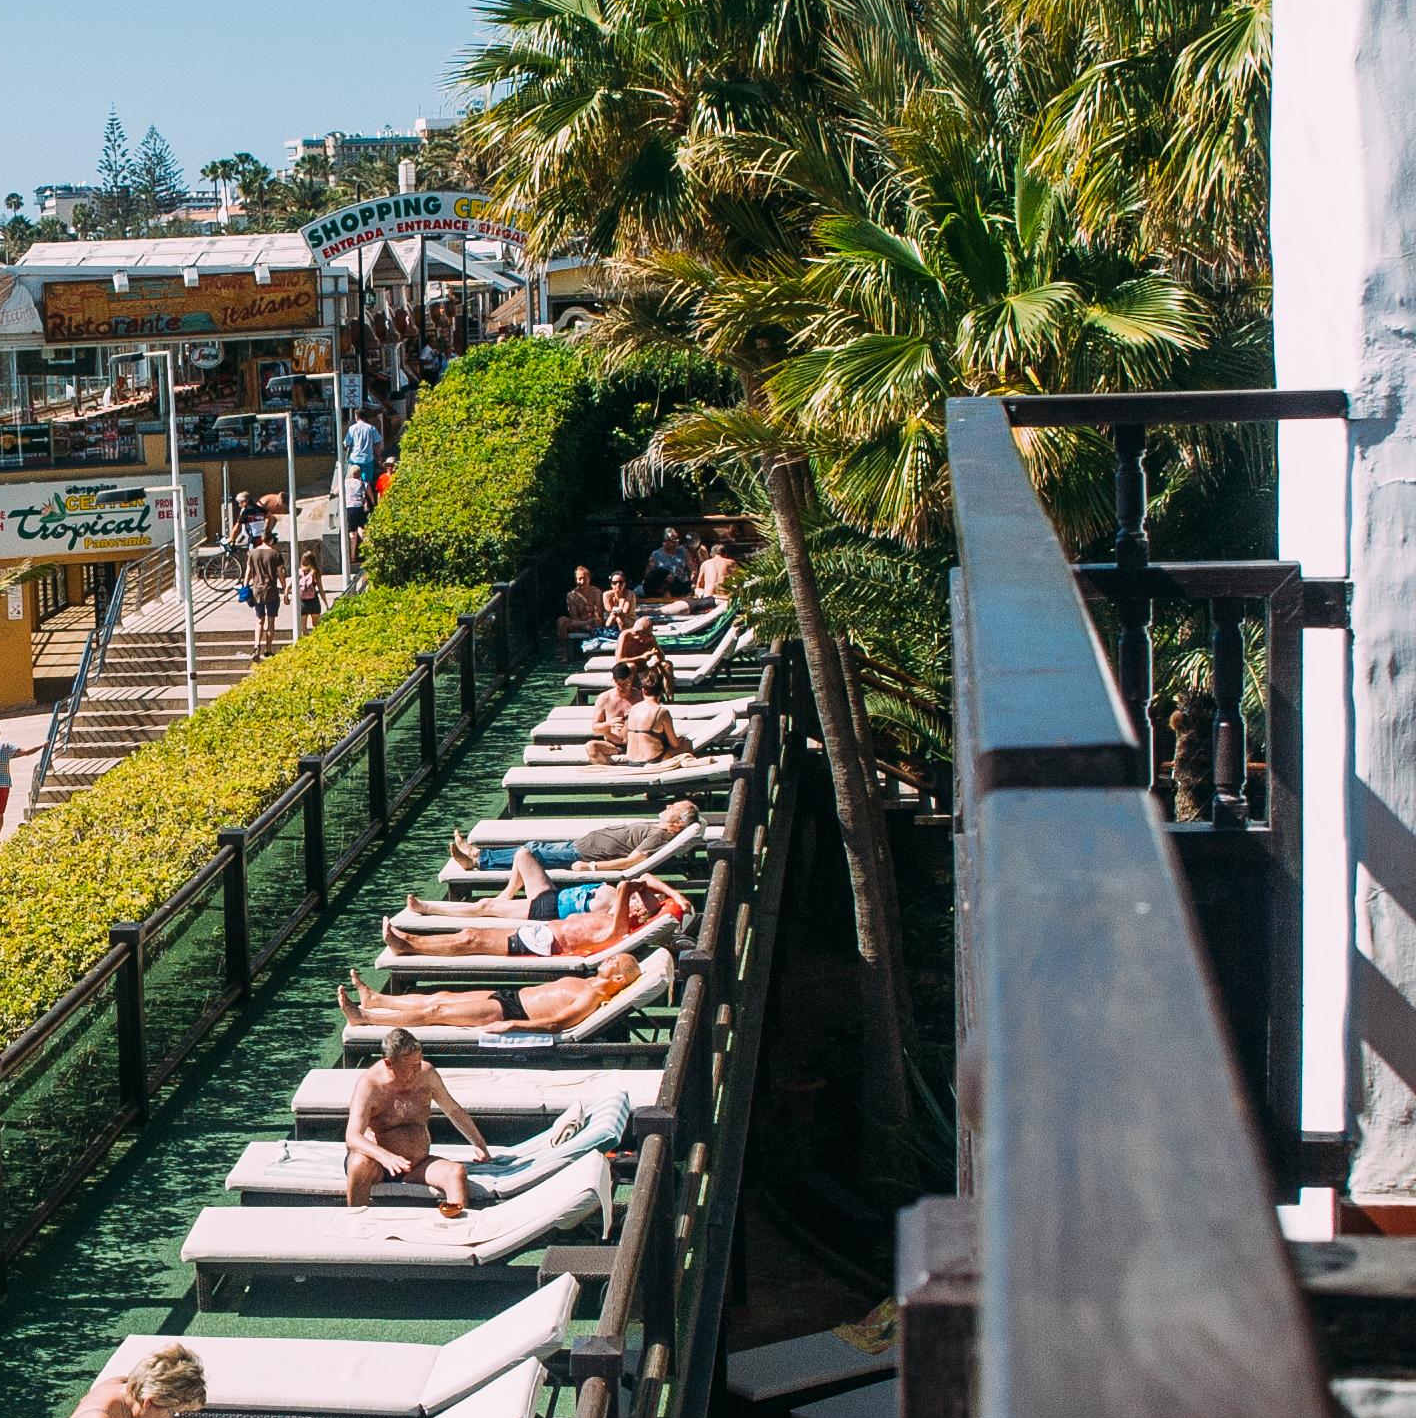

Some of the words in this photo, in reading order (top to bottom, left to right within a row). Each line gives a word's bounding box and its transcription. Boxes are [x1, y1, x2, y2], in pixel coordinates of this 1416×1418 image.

[307, 195, 442, 249] SHOPPING
[322, 227, 384, 260] ENTRADA
[396, 218, 469, 234] ENTRANCE
[47, 313, 182, 338] Ristorante
[221, 291, 311, 327] Italiano
[84, 534, 152, 549] Panoramic
